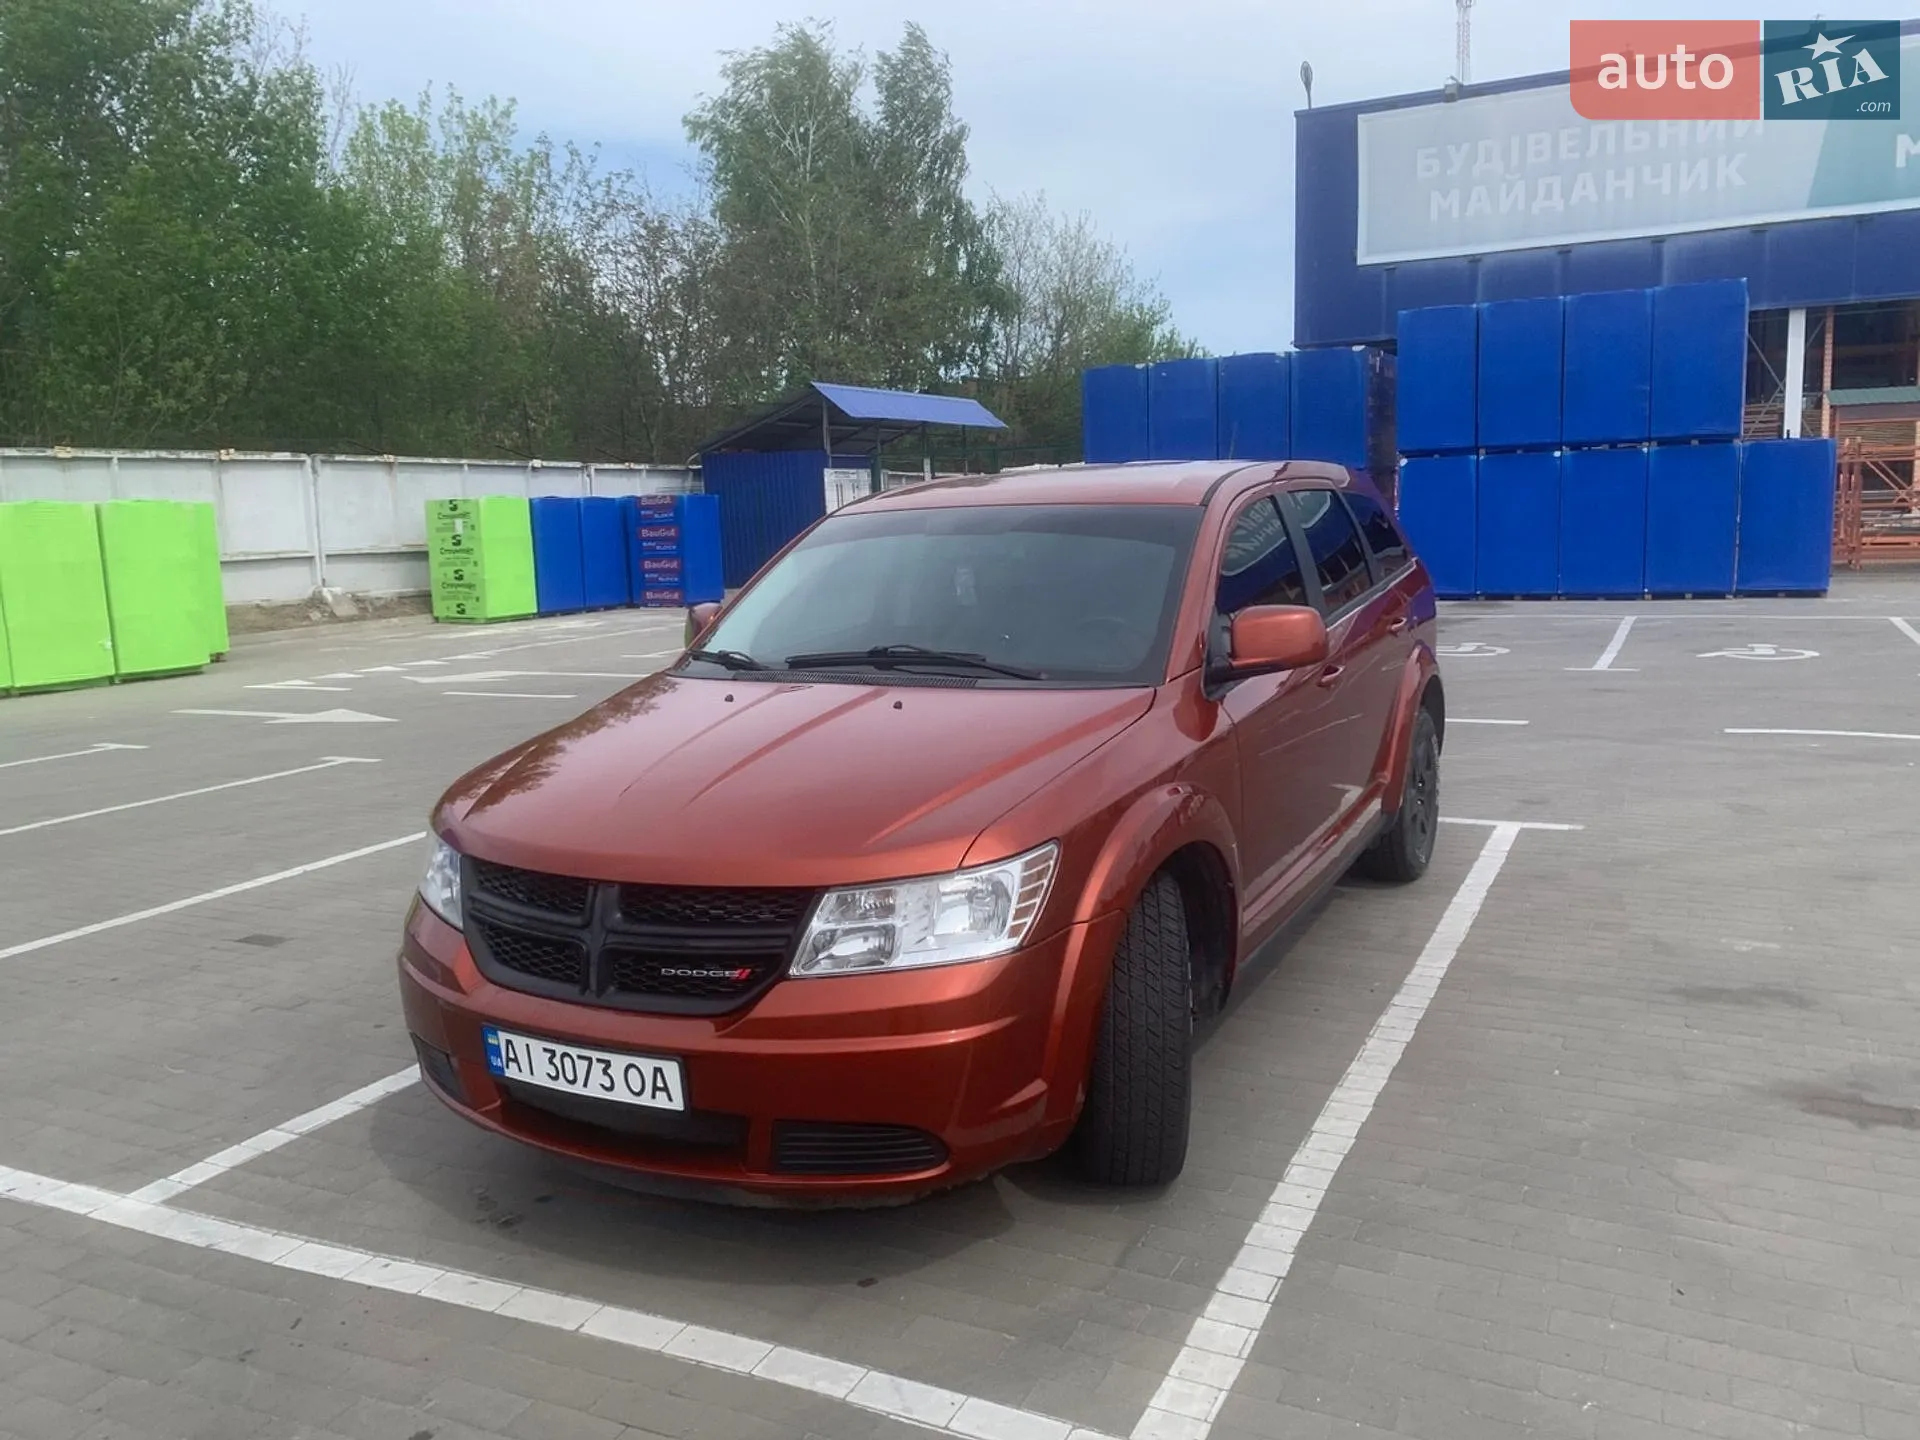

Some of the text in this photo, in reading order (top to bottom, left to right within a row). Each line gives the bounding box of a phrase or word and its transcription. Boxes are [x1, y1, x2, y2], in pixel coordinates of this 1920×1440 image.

[1430, 153, 1747, 222] МАЙДАНЧИК
[505, 1038, 673, 1102] AI 3073 OA
